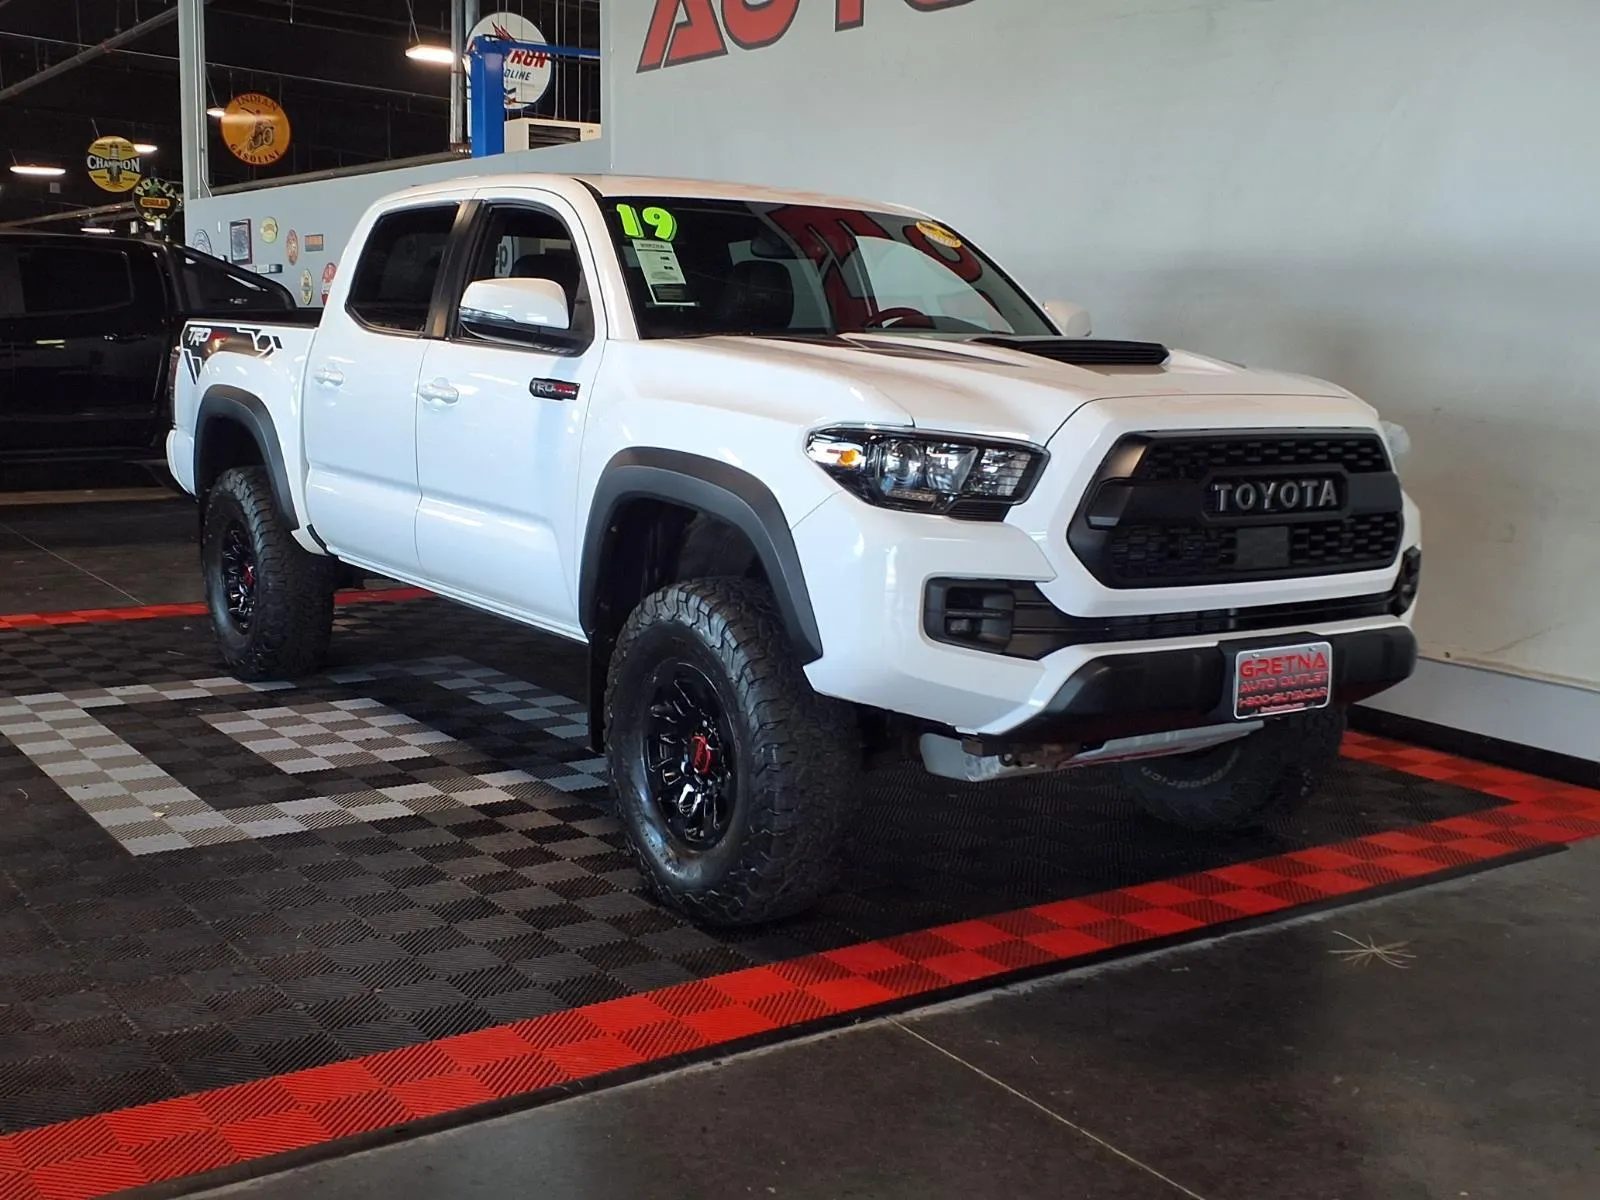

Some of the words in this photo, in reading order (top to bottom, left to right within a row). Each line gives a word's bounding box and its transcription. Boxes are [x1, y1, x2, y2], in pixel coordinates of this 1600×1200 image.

[86, 155, 140, 173] CHAMPION
[616, 204, 677, 242] 19
[189, 327, 212, 347] TRD
[1212, 480, 1338, 512] TOYOTA
[1240, 652, 1328, 679] GRETNA
